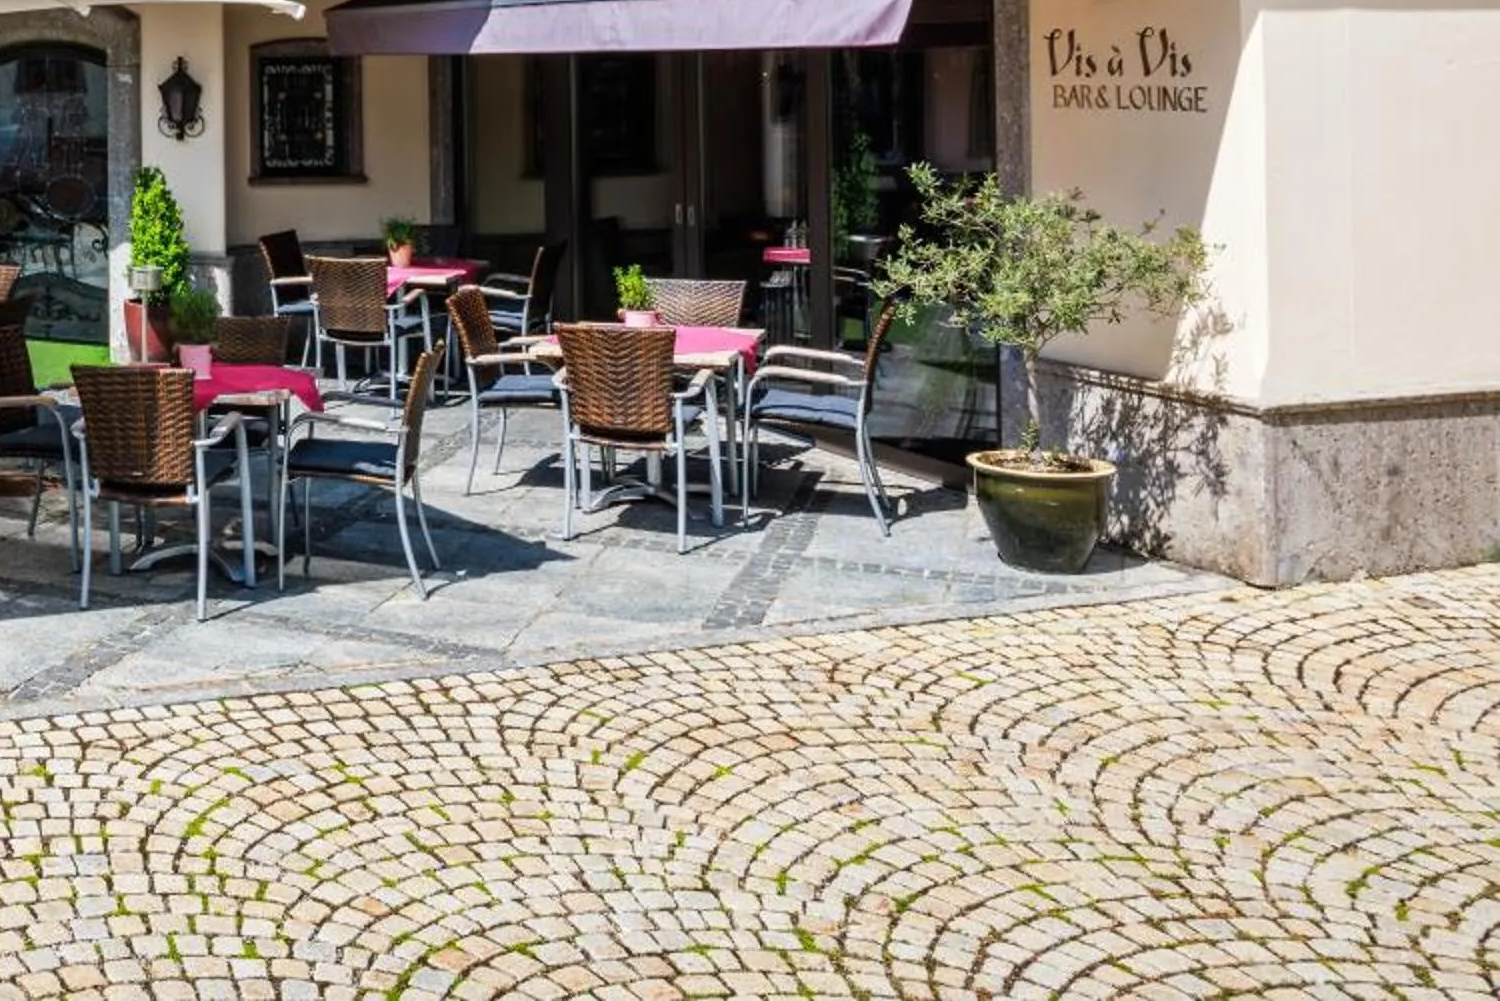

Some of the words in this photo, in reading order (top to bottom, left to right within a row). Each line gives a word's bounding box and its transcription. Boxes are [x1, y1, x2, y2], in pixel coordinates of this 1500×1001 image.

[1043, 28, 1097, 78] Vis
[1107, 45, 1124, 77] à
[1136, 26, 1192, 78] Vis
[1116, 85, 1208, 113] LOUNGE
